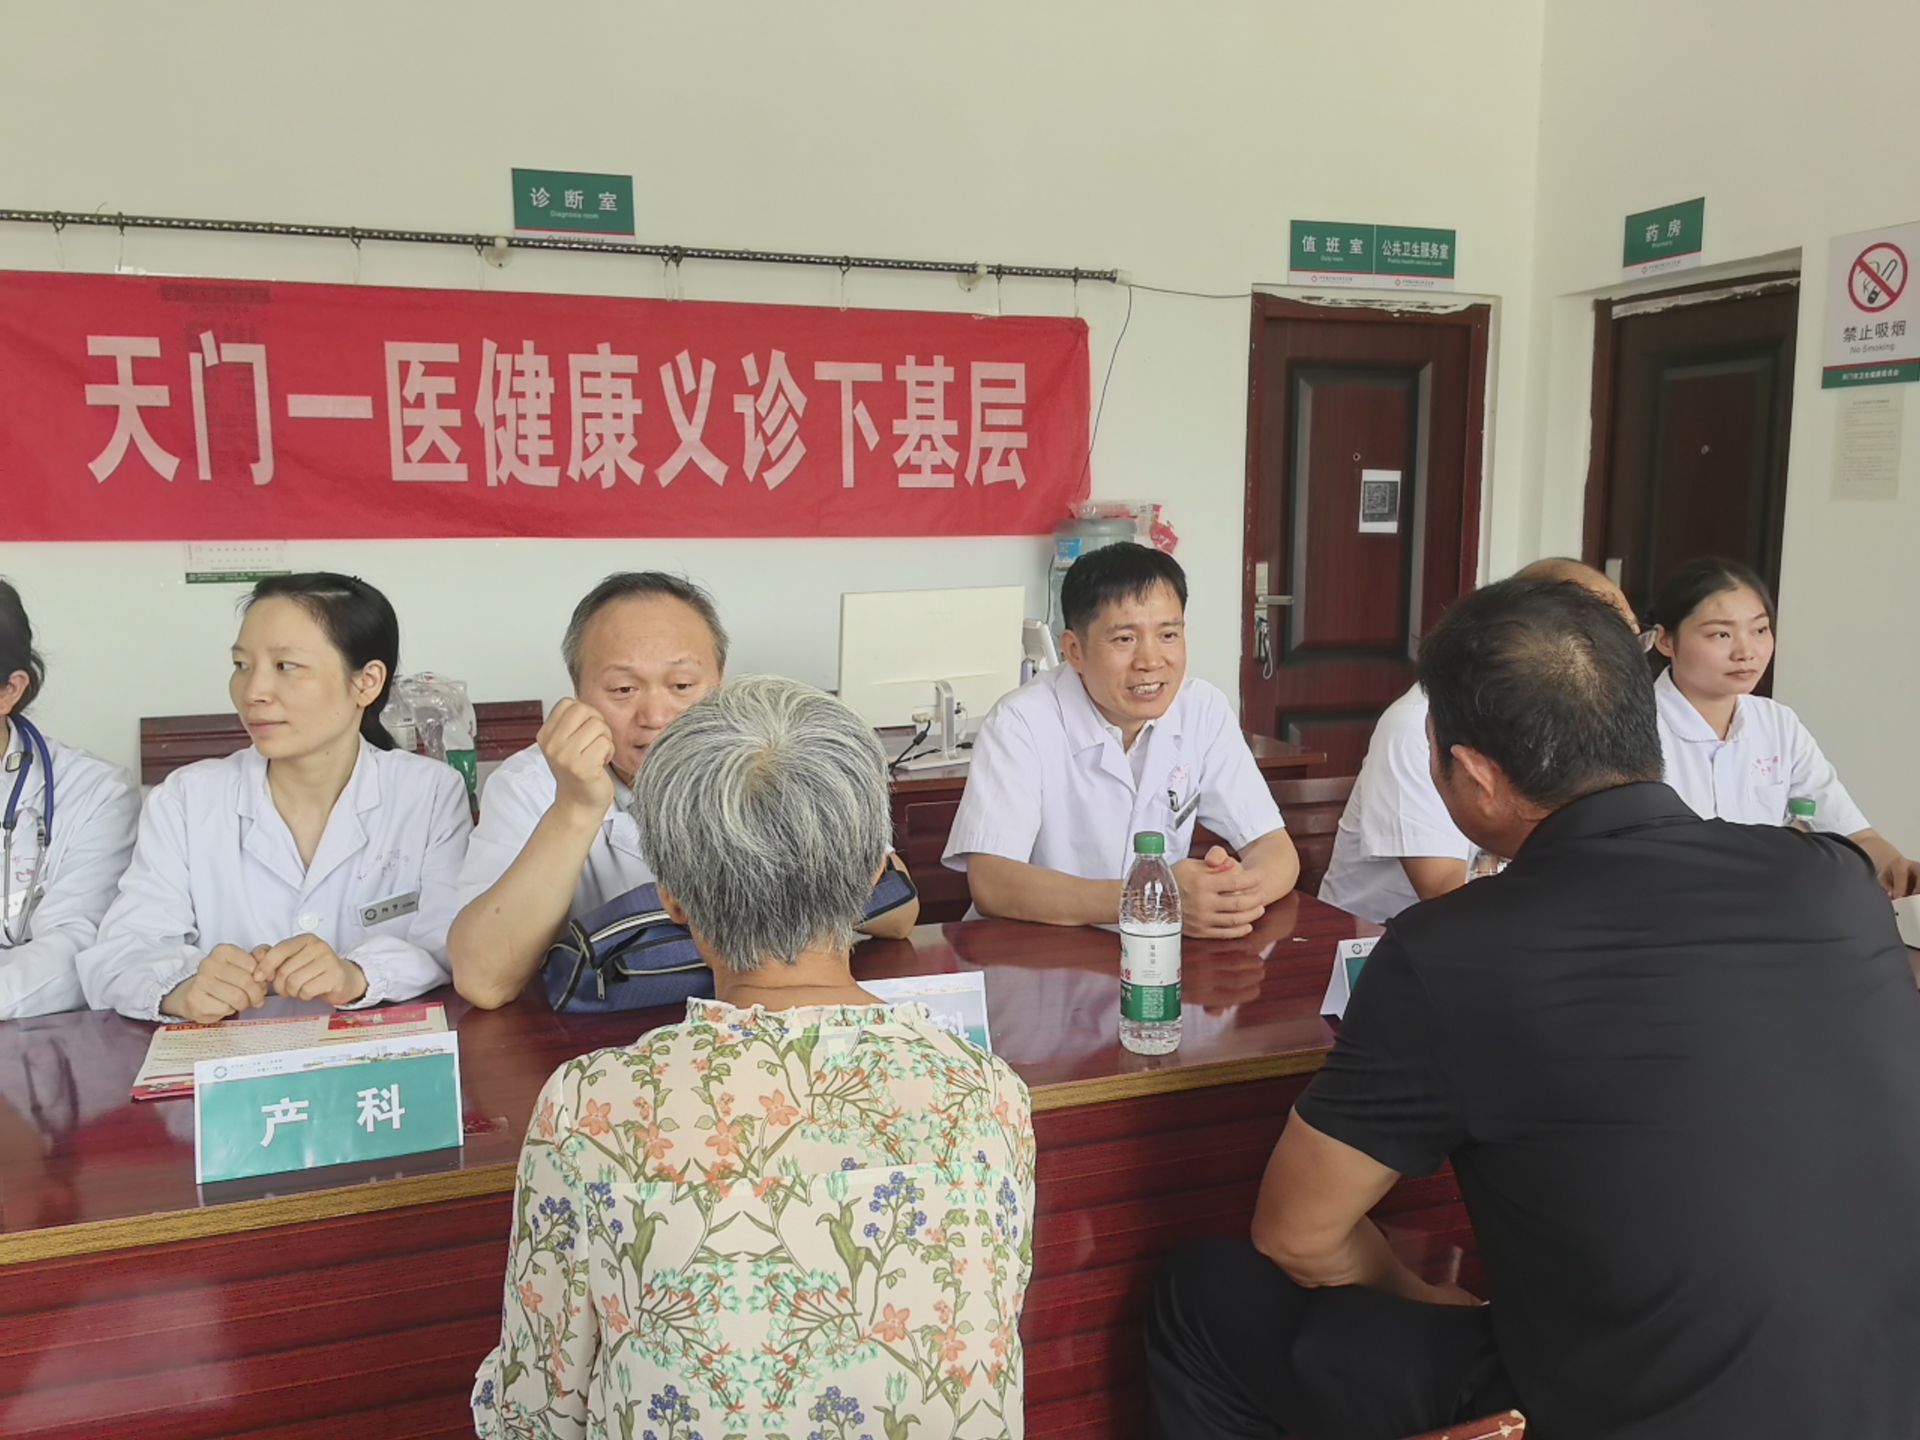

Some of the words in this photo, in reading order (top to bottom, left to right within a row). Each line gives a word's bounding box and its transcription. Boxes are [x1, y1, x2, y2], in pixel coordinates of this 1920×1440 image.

[530, 187, 617, 211] 诊断室
[1645, 219, 1681, 242] 药房
[1302, 235, 1363, 253] 值班室
[1382, 240, 1449, 260] 公共卫生服务室
[1842, 320, 1906, 343] 禁止吸烟
[1862, 343, 1895, 353] Smoking
[85, 330, 1027, 488] 天门一医健康义诊下基层
[260, 1084, 405, 1147] 产科
